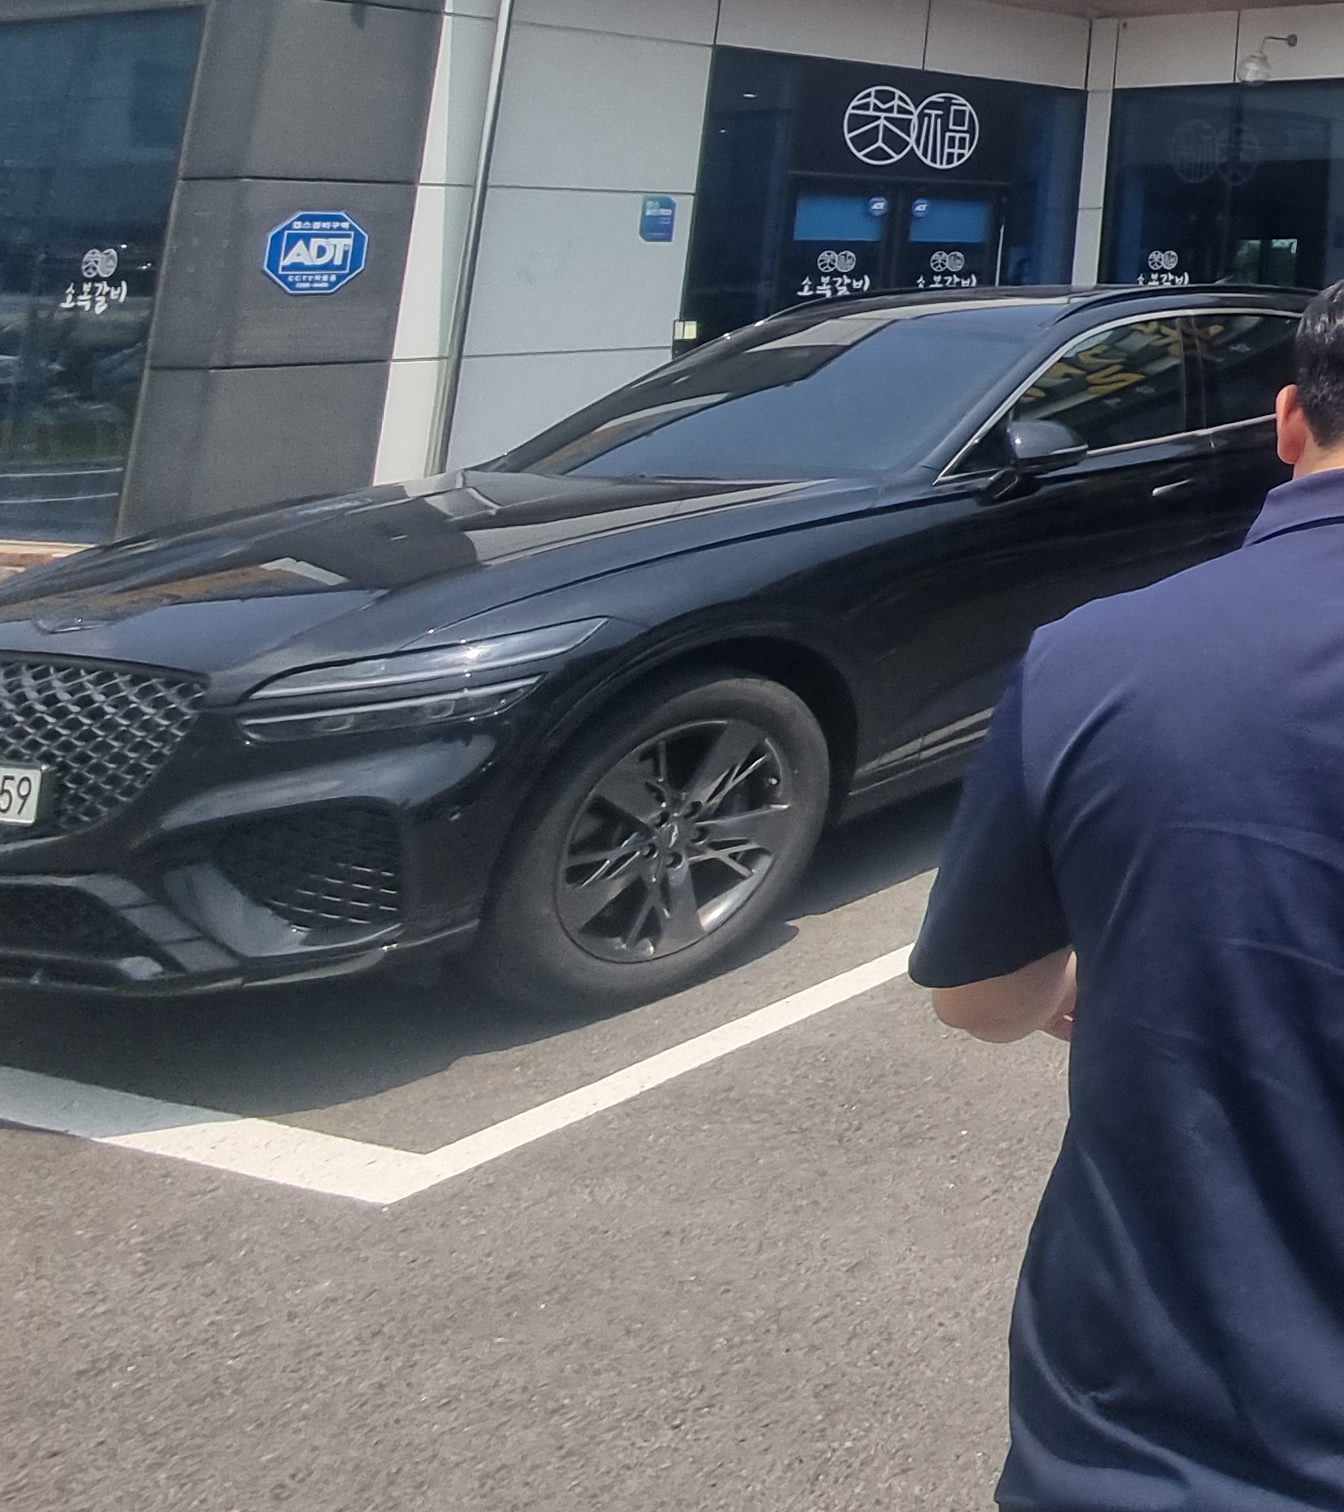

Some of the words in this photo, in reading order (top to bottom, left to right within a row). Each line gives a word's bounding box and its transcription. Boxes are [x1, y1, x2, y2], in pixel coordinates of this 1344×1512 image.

[281, 238, 354, 266] ADT
[60, 281, 128, 315] 소복갈비
[0, 775, 32, 815] 59
